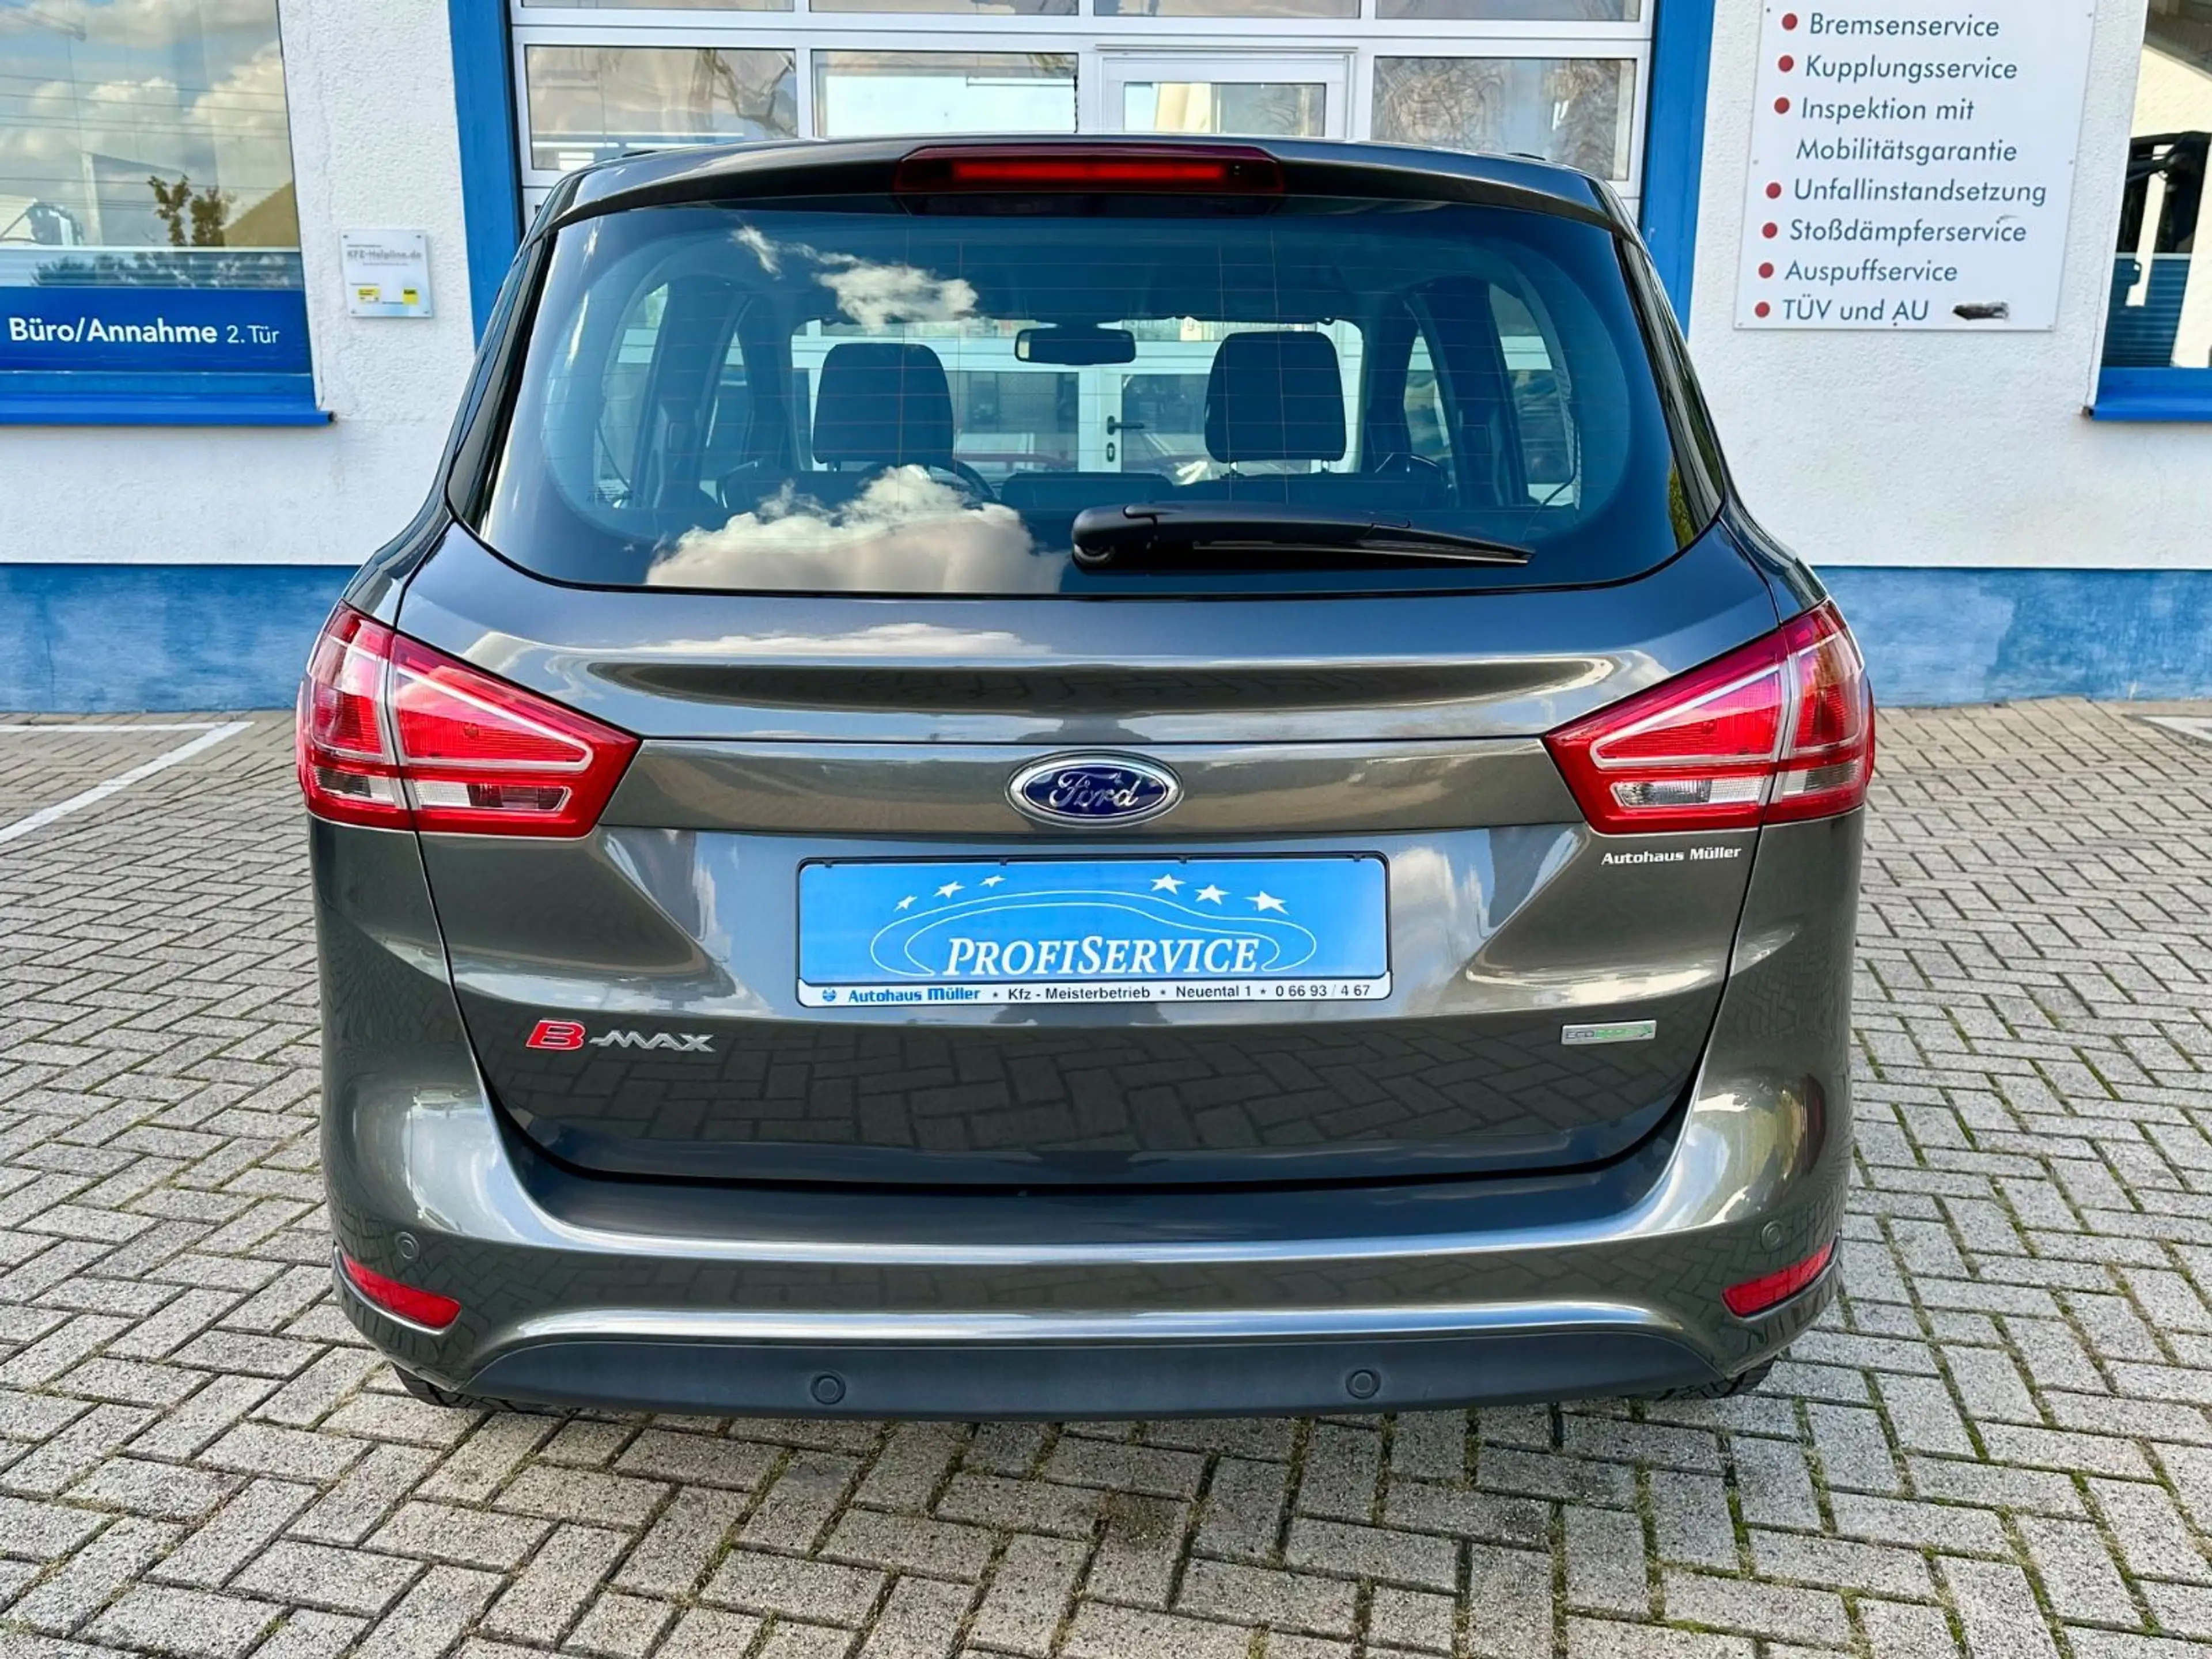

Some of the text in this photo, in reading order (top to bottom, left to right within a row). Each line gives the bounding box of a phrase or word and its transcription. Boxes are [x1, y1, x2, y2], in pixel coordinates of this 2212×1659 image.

[1809, 13, 1999, 37] Bremsenservice
[1805, 55, 2017, 84] Kupplungsservice
[1802, 97, 1974, 124] Inspektion mit
[1796, 137, 2017, 165] Mobilitätsgarantie
[1794, 179, 2047, 206] Unfallinstandsetzung
[1790, 218, 2027, 247] Stoßdämpferservice
[1784, 259, 1958, 286] Auspuffservice
[1783, 294, 1929, 320] TÜV und AU
[8, 317, 281, 344] Büro/Annahme 2. Tür
[1048, 771, 1143, 808] Ford
[1601, 846, 1742, 865] Autohaus Müller
[848, 988, 922, 1002] Autohaus
[927, 987, 981, 1001] Müller
[1007, 988, 1032, 1001] Kfz
[1045, 986, 1150, 1000] Meisterbetrieb
[1176, 985, 1240, 998] Neuental
[1245, 985, 1251, 997] 1
[1275, 984, 1283, 997] 0
[1288, 984, 1306, 997] 66
[1310, 984, 1327, 997] 93
[1340, 984, 1349, 997] 4
[1354, 984, 1370, 997] 67
[525, 1017, 717, 1052] B-MAX
